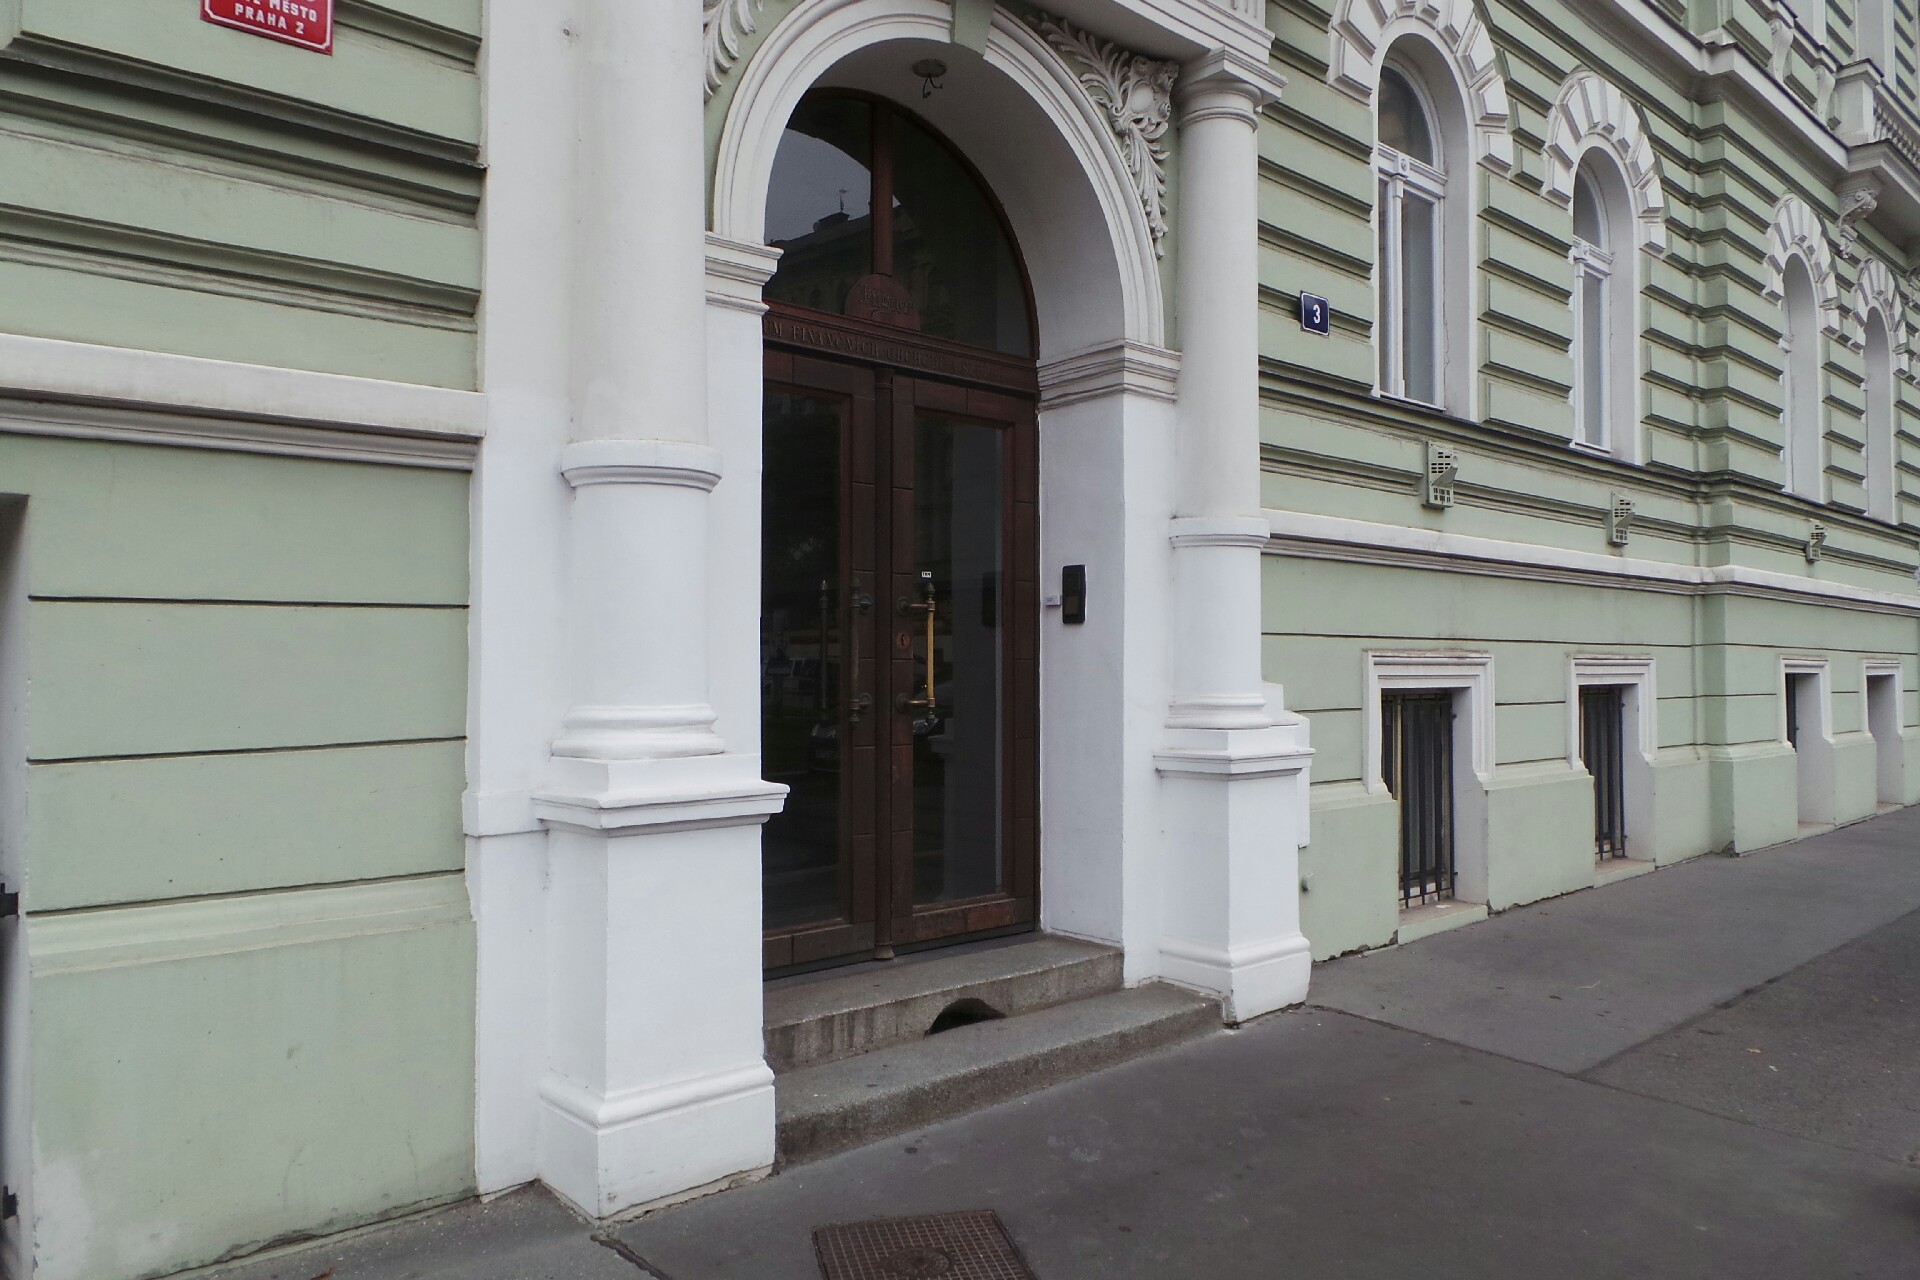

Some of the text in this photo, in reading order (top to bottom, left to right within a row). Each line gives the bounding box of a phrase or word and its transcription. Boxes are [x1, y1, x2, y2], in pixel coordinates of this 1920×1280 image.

[234, 3, 304, 34] PRAHA 2
[1313, 304, 1321, 324] 3
